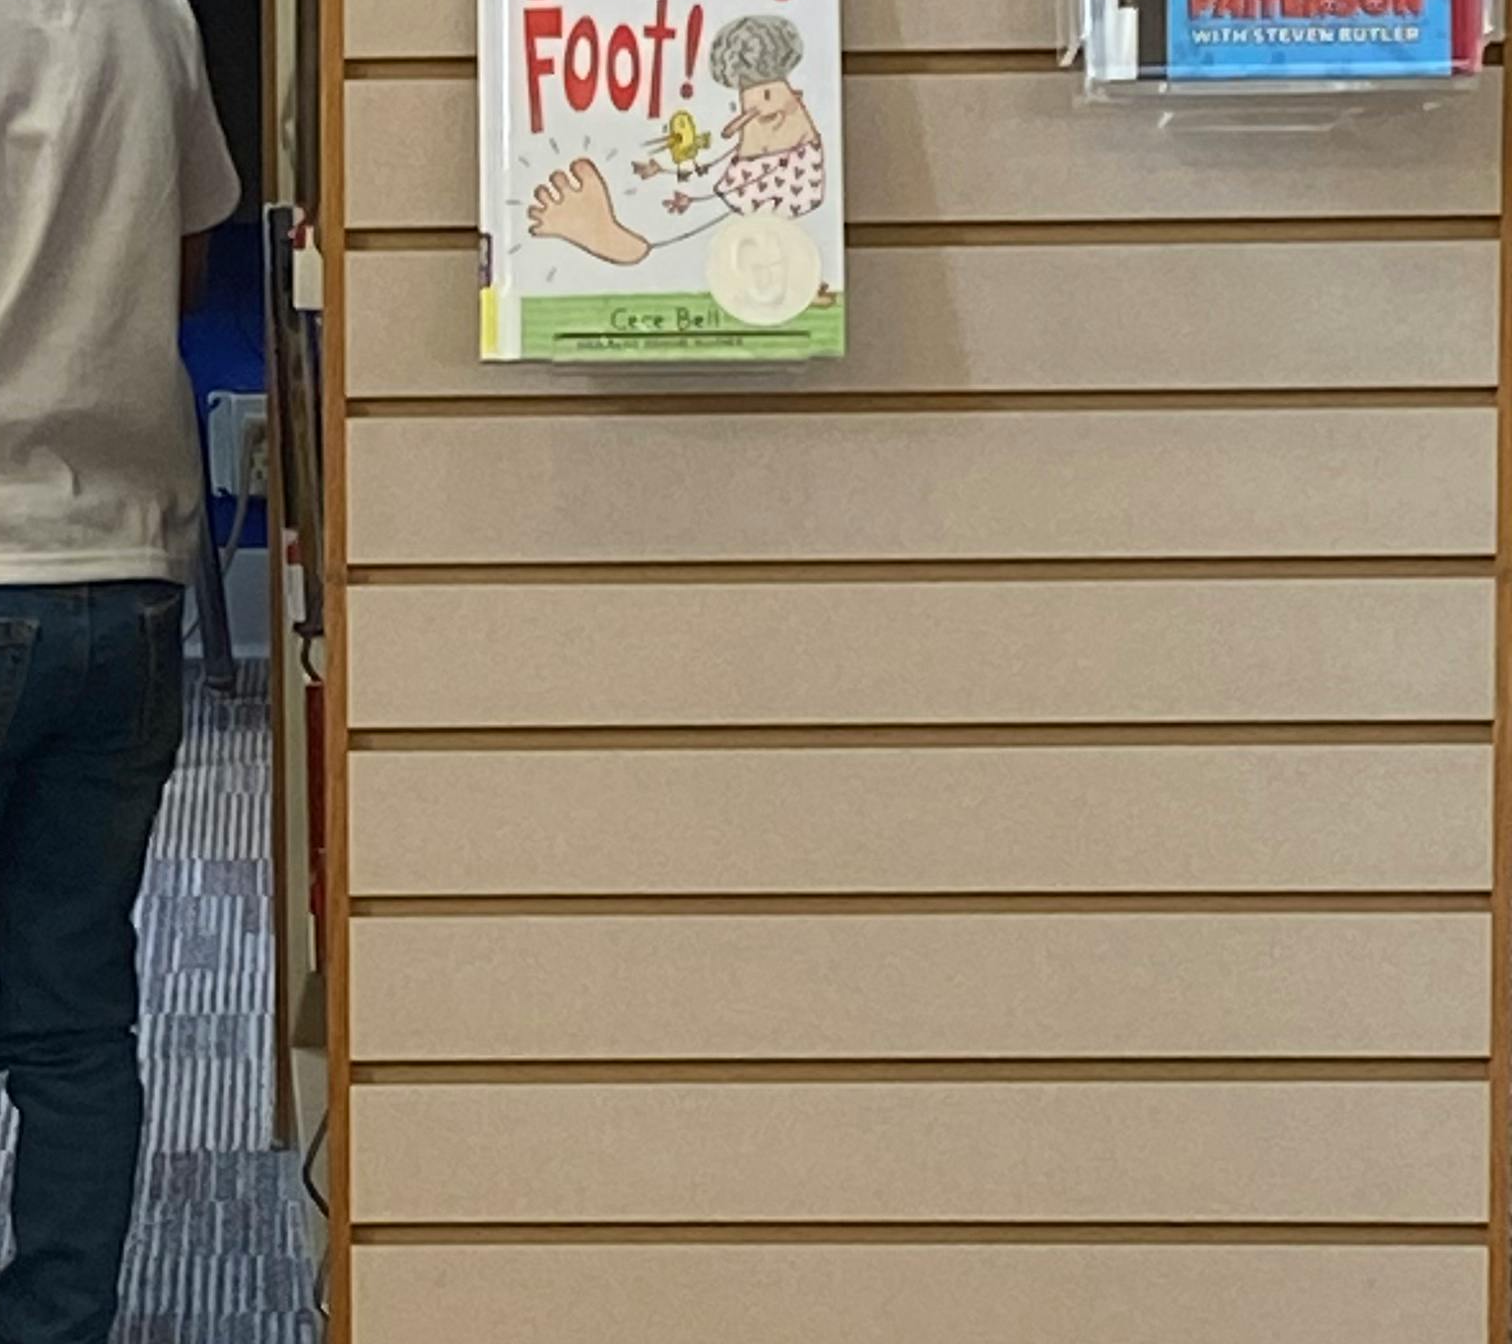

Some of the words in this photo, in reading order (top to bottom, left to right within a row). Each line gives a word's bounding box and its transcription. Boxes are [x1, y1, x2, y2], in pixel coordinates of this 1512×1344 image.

[1191, 28, 1249, 44] WITH
[1253, 27, 1335, 43] STEVEN
[1338, 25, 1421, 43] BUTLER
